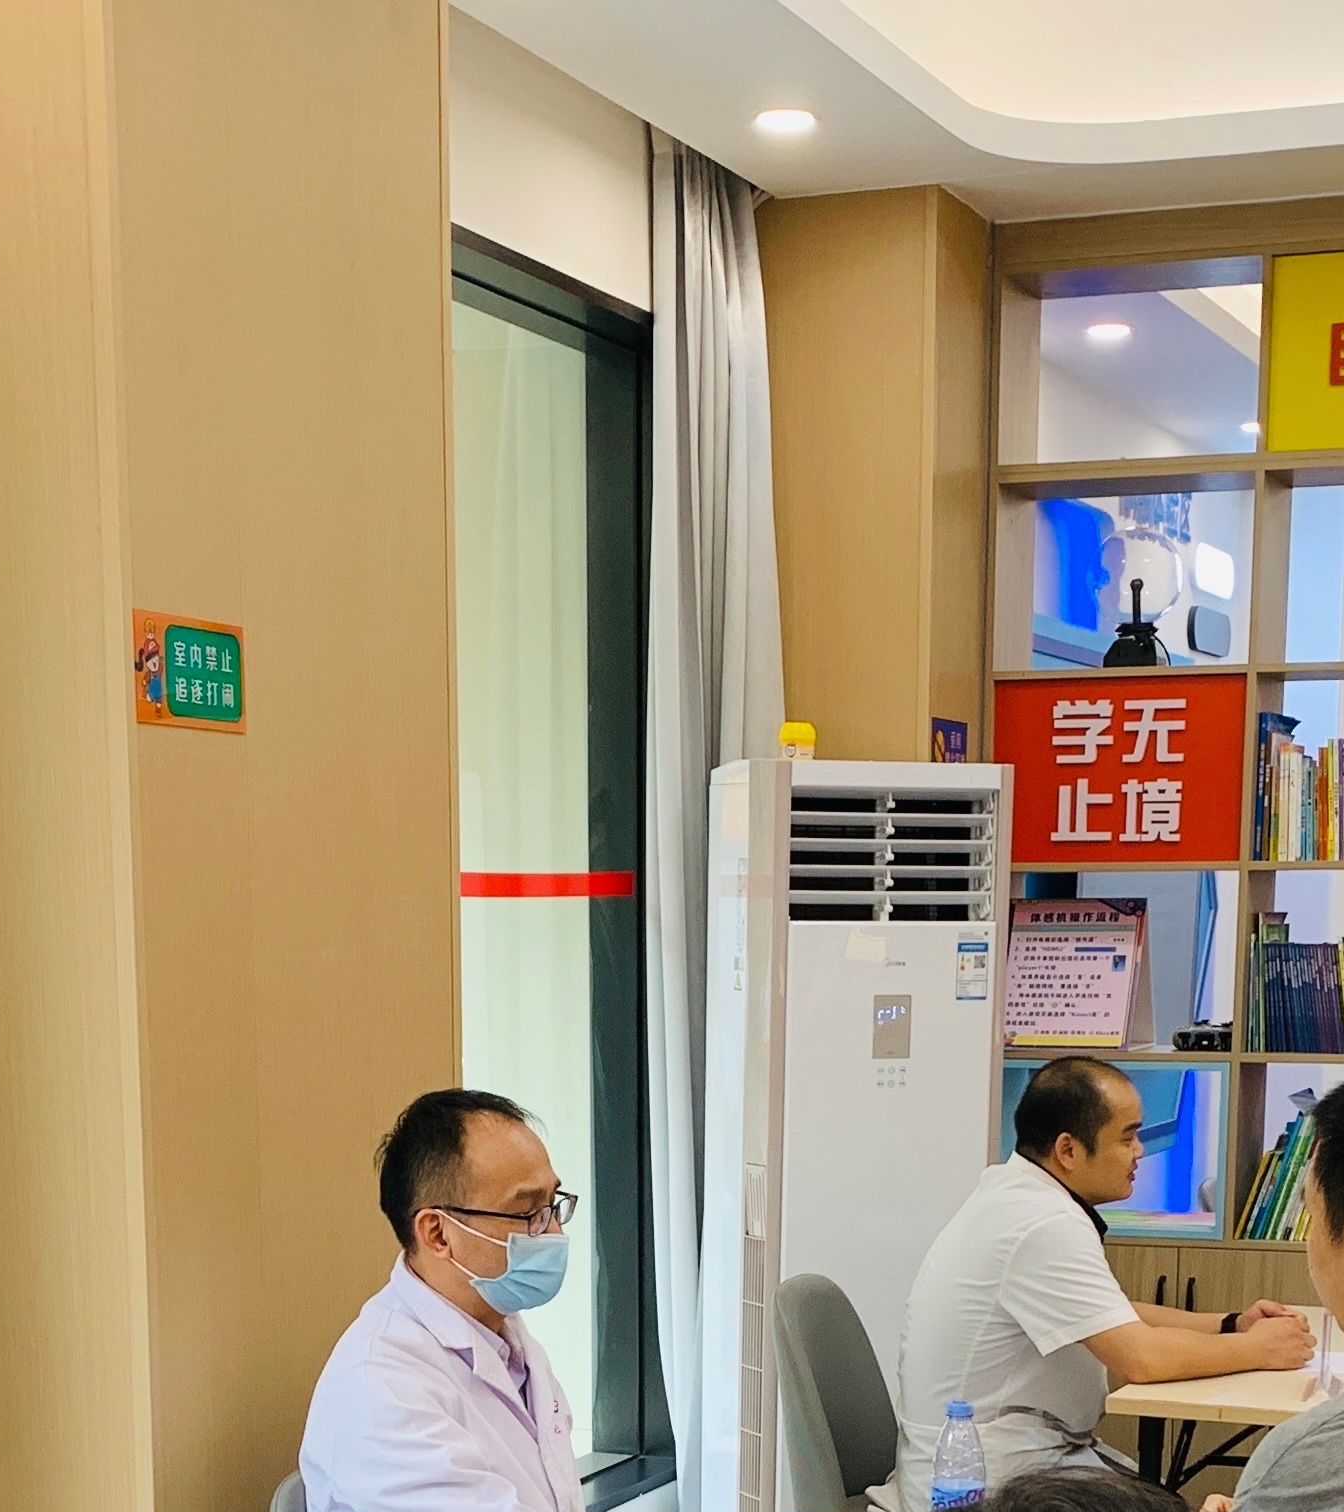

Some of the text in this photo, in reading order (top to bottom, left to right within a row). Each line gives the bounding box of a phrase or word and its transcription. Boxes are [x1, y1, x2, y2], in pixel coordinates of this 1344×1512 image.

[172, 640, 234, 673] 室内禁止
[174, 676, 235, 708] 追逐打闹
[1051, 698, 1187, 765] 学无
[1049, 778, 1184, 842] 止境
[1029, 911, 1121, 924] 体感机操作流程
